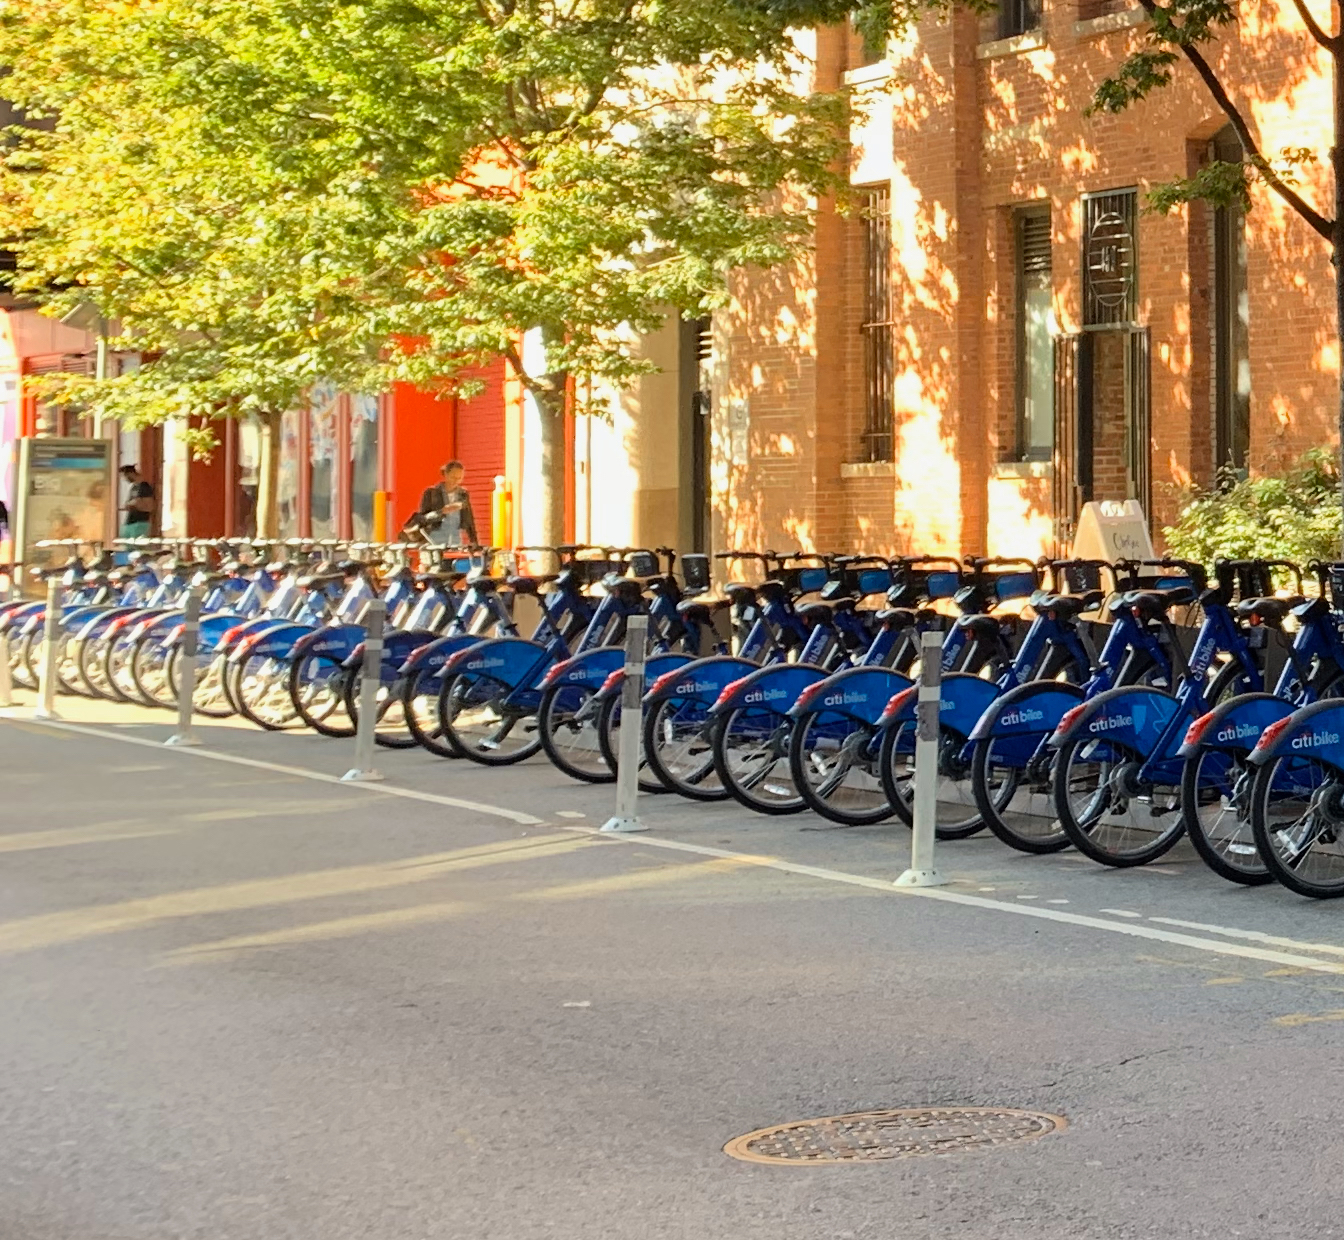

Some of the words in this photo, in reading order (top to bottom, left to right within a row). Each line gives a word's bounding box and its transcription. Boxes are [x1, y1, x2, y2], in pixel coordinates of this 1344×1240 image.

[1089, 718, 1108, 733] citi
[1109, 714, 1133, 729] bike
[1312, 730, 1340, 747] bike
